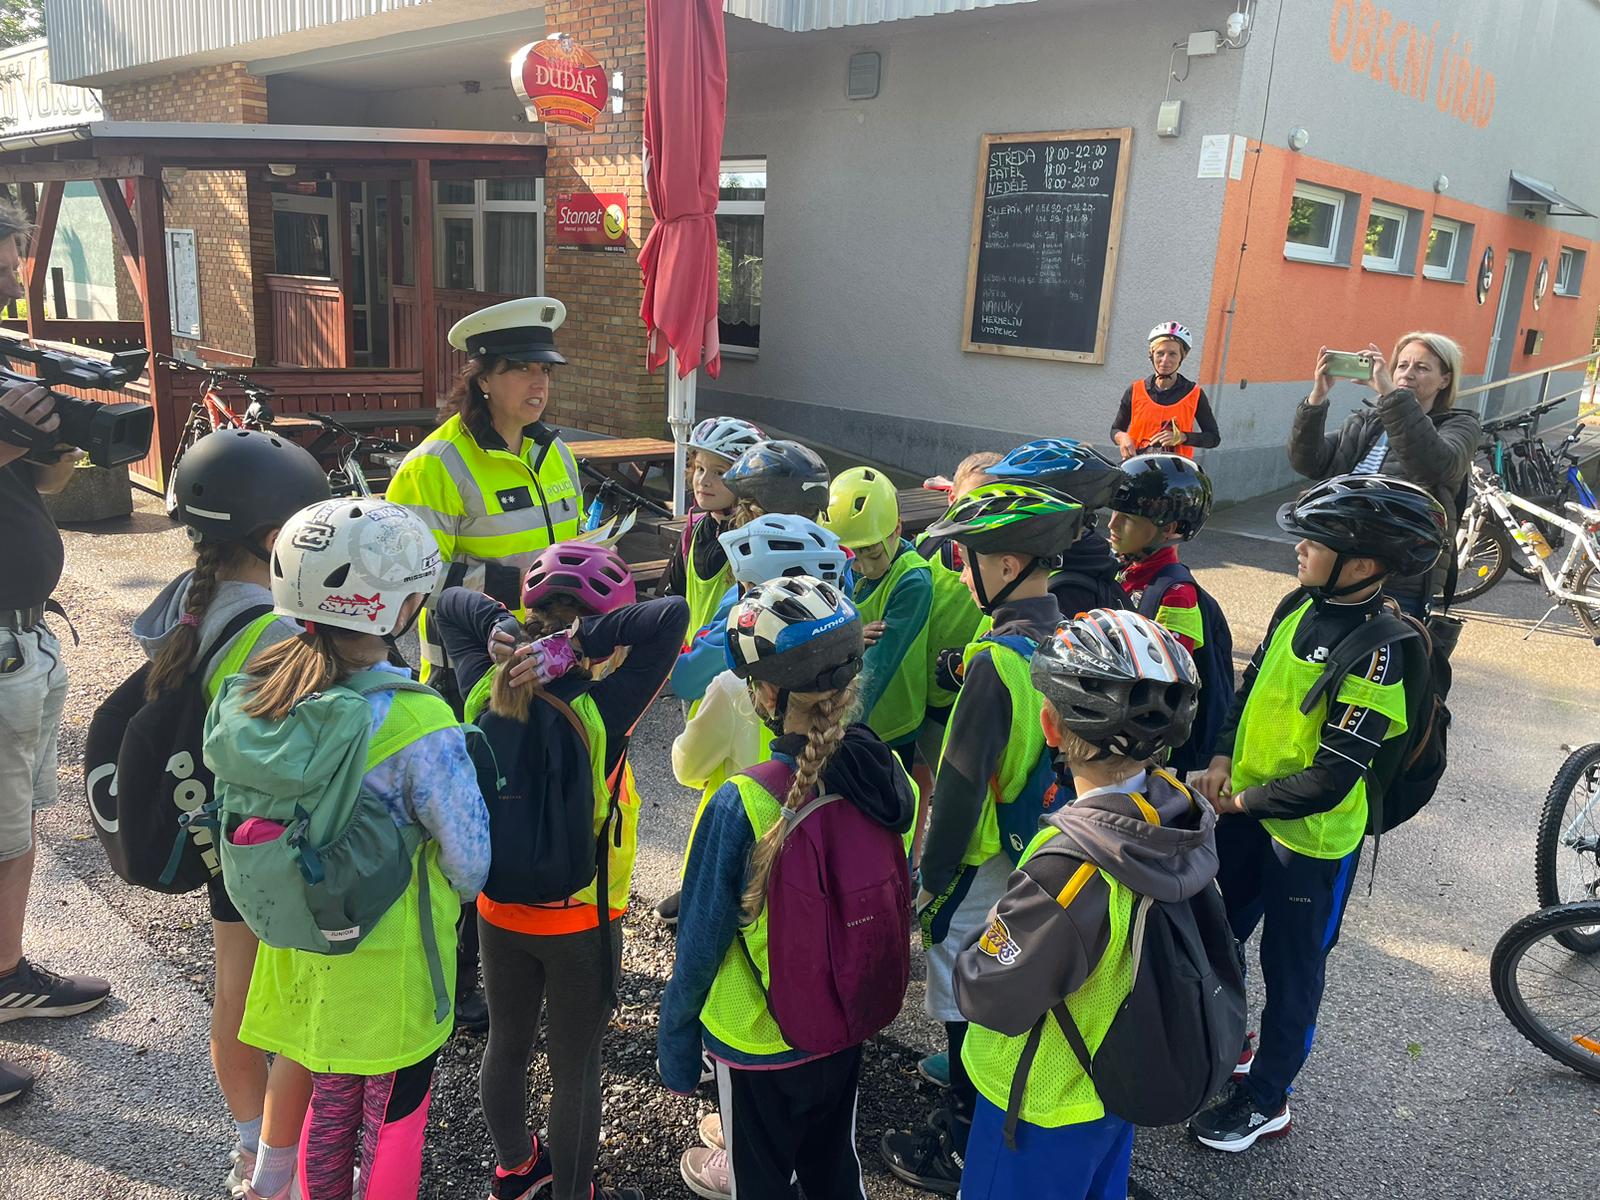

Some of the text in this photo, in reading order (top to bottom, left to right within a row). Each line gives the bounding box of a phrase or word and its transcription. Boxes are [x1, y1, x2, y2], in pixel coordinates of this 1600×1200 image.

[1329, 0, 1496, 129] OBECNÍ ÚŘAD
[558, 206, 603, 225] Starnet
